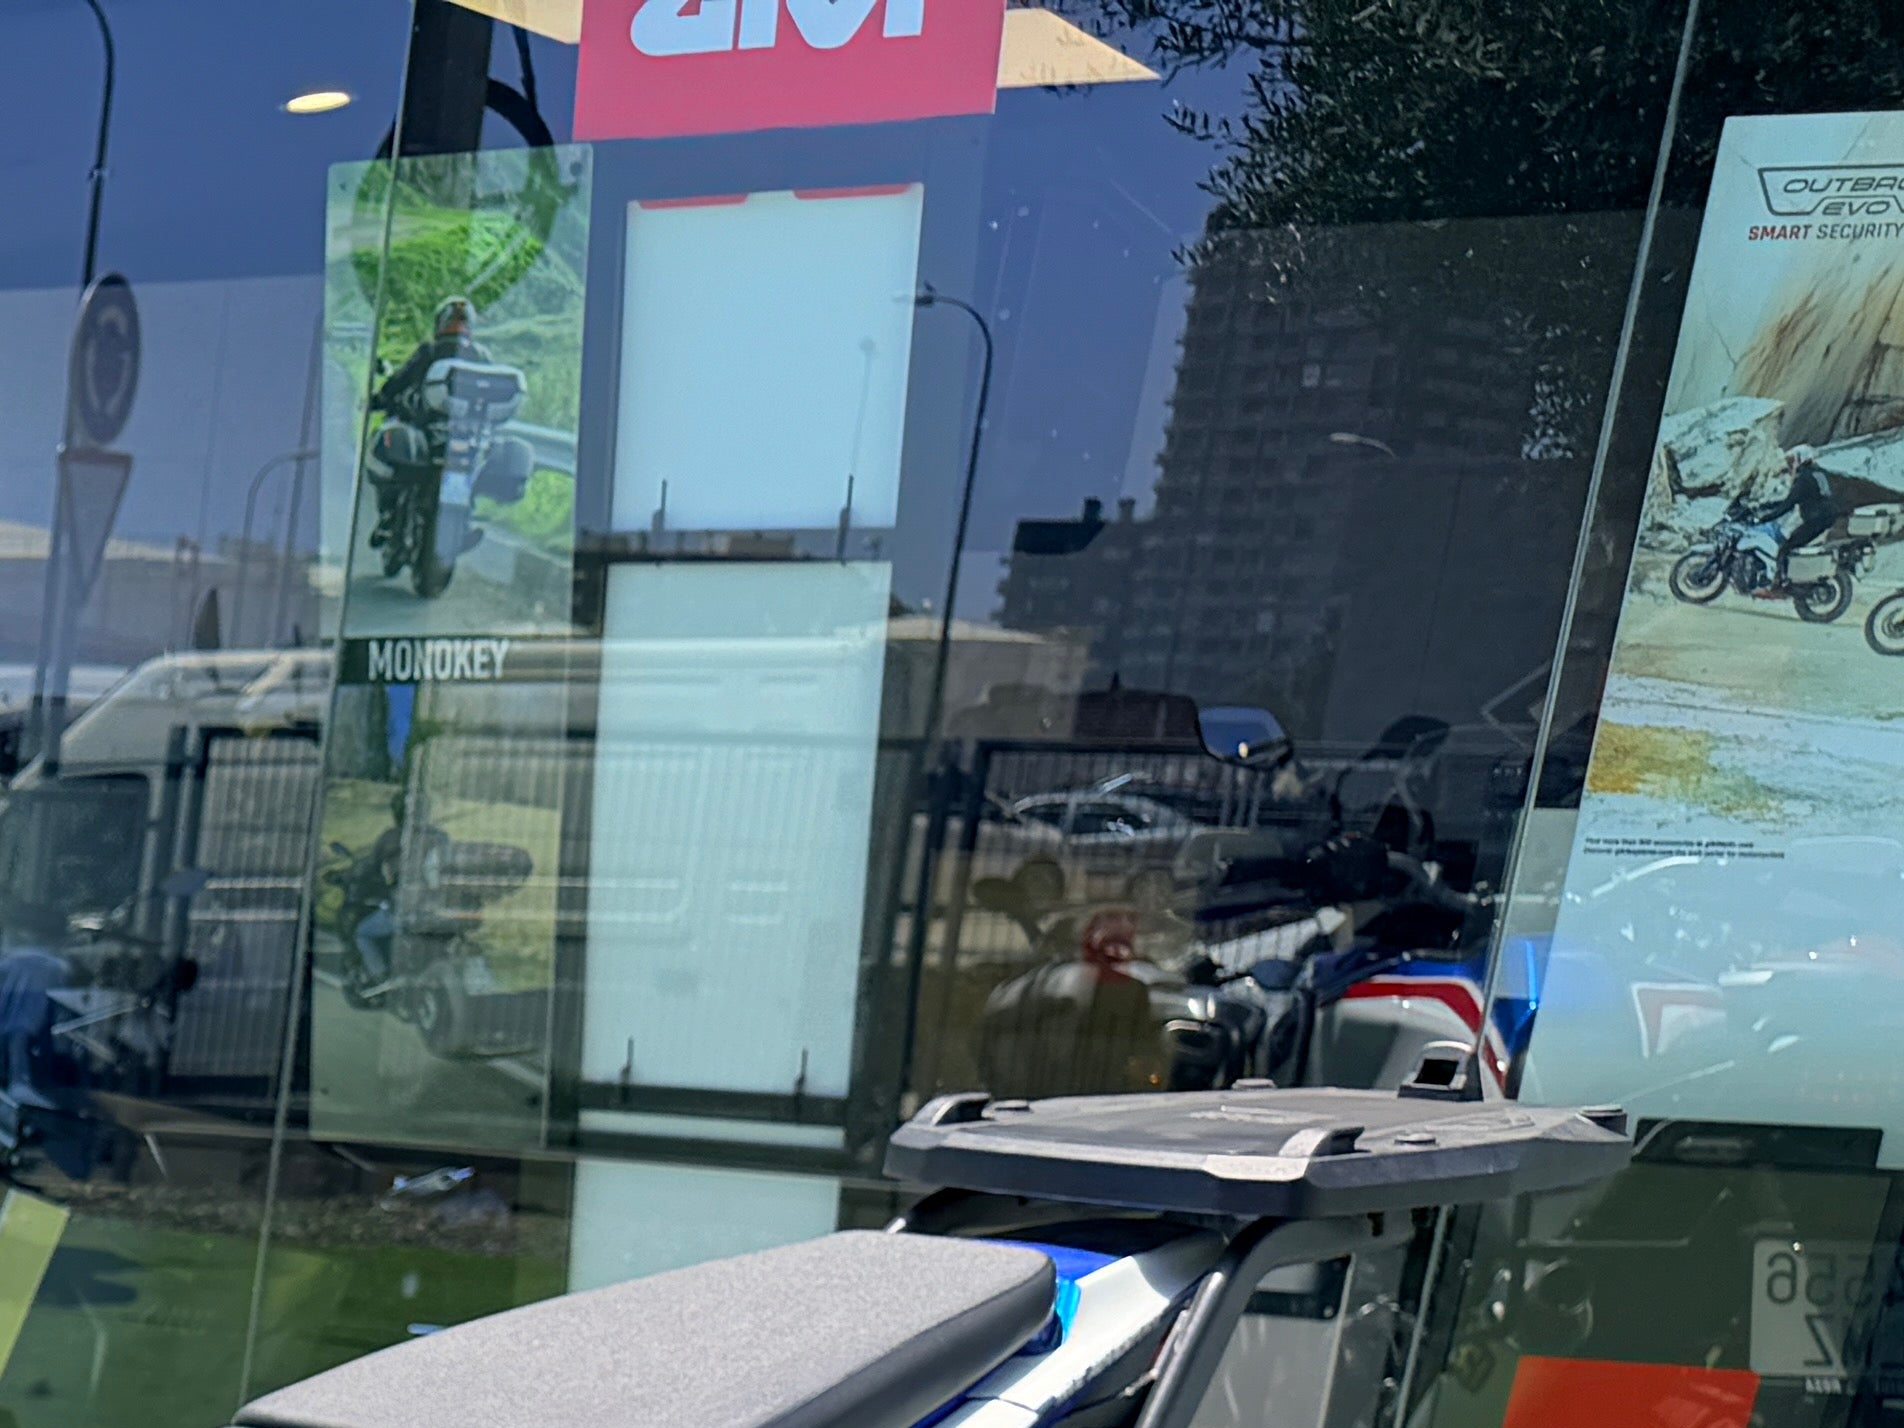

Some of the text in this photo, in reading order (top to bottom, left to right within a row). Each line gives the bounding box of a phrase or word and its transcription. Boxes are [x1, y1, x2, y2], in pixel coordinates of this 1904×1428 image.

[1782, 176, 1904, 194] OUTBA
[1821, 200, 1891, 216] EVO
[1748, 222, 1904, 241] SMART SECURITY
[368, 638, 510, 682] MONOKEY
